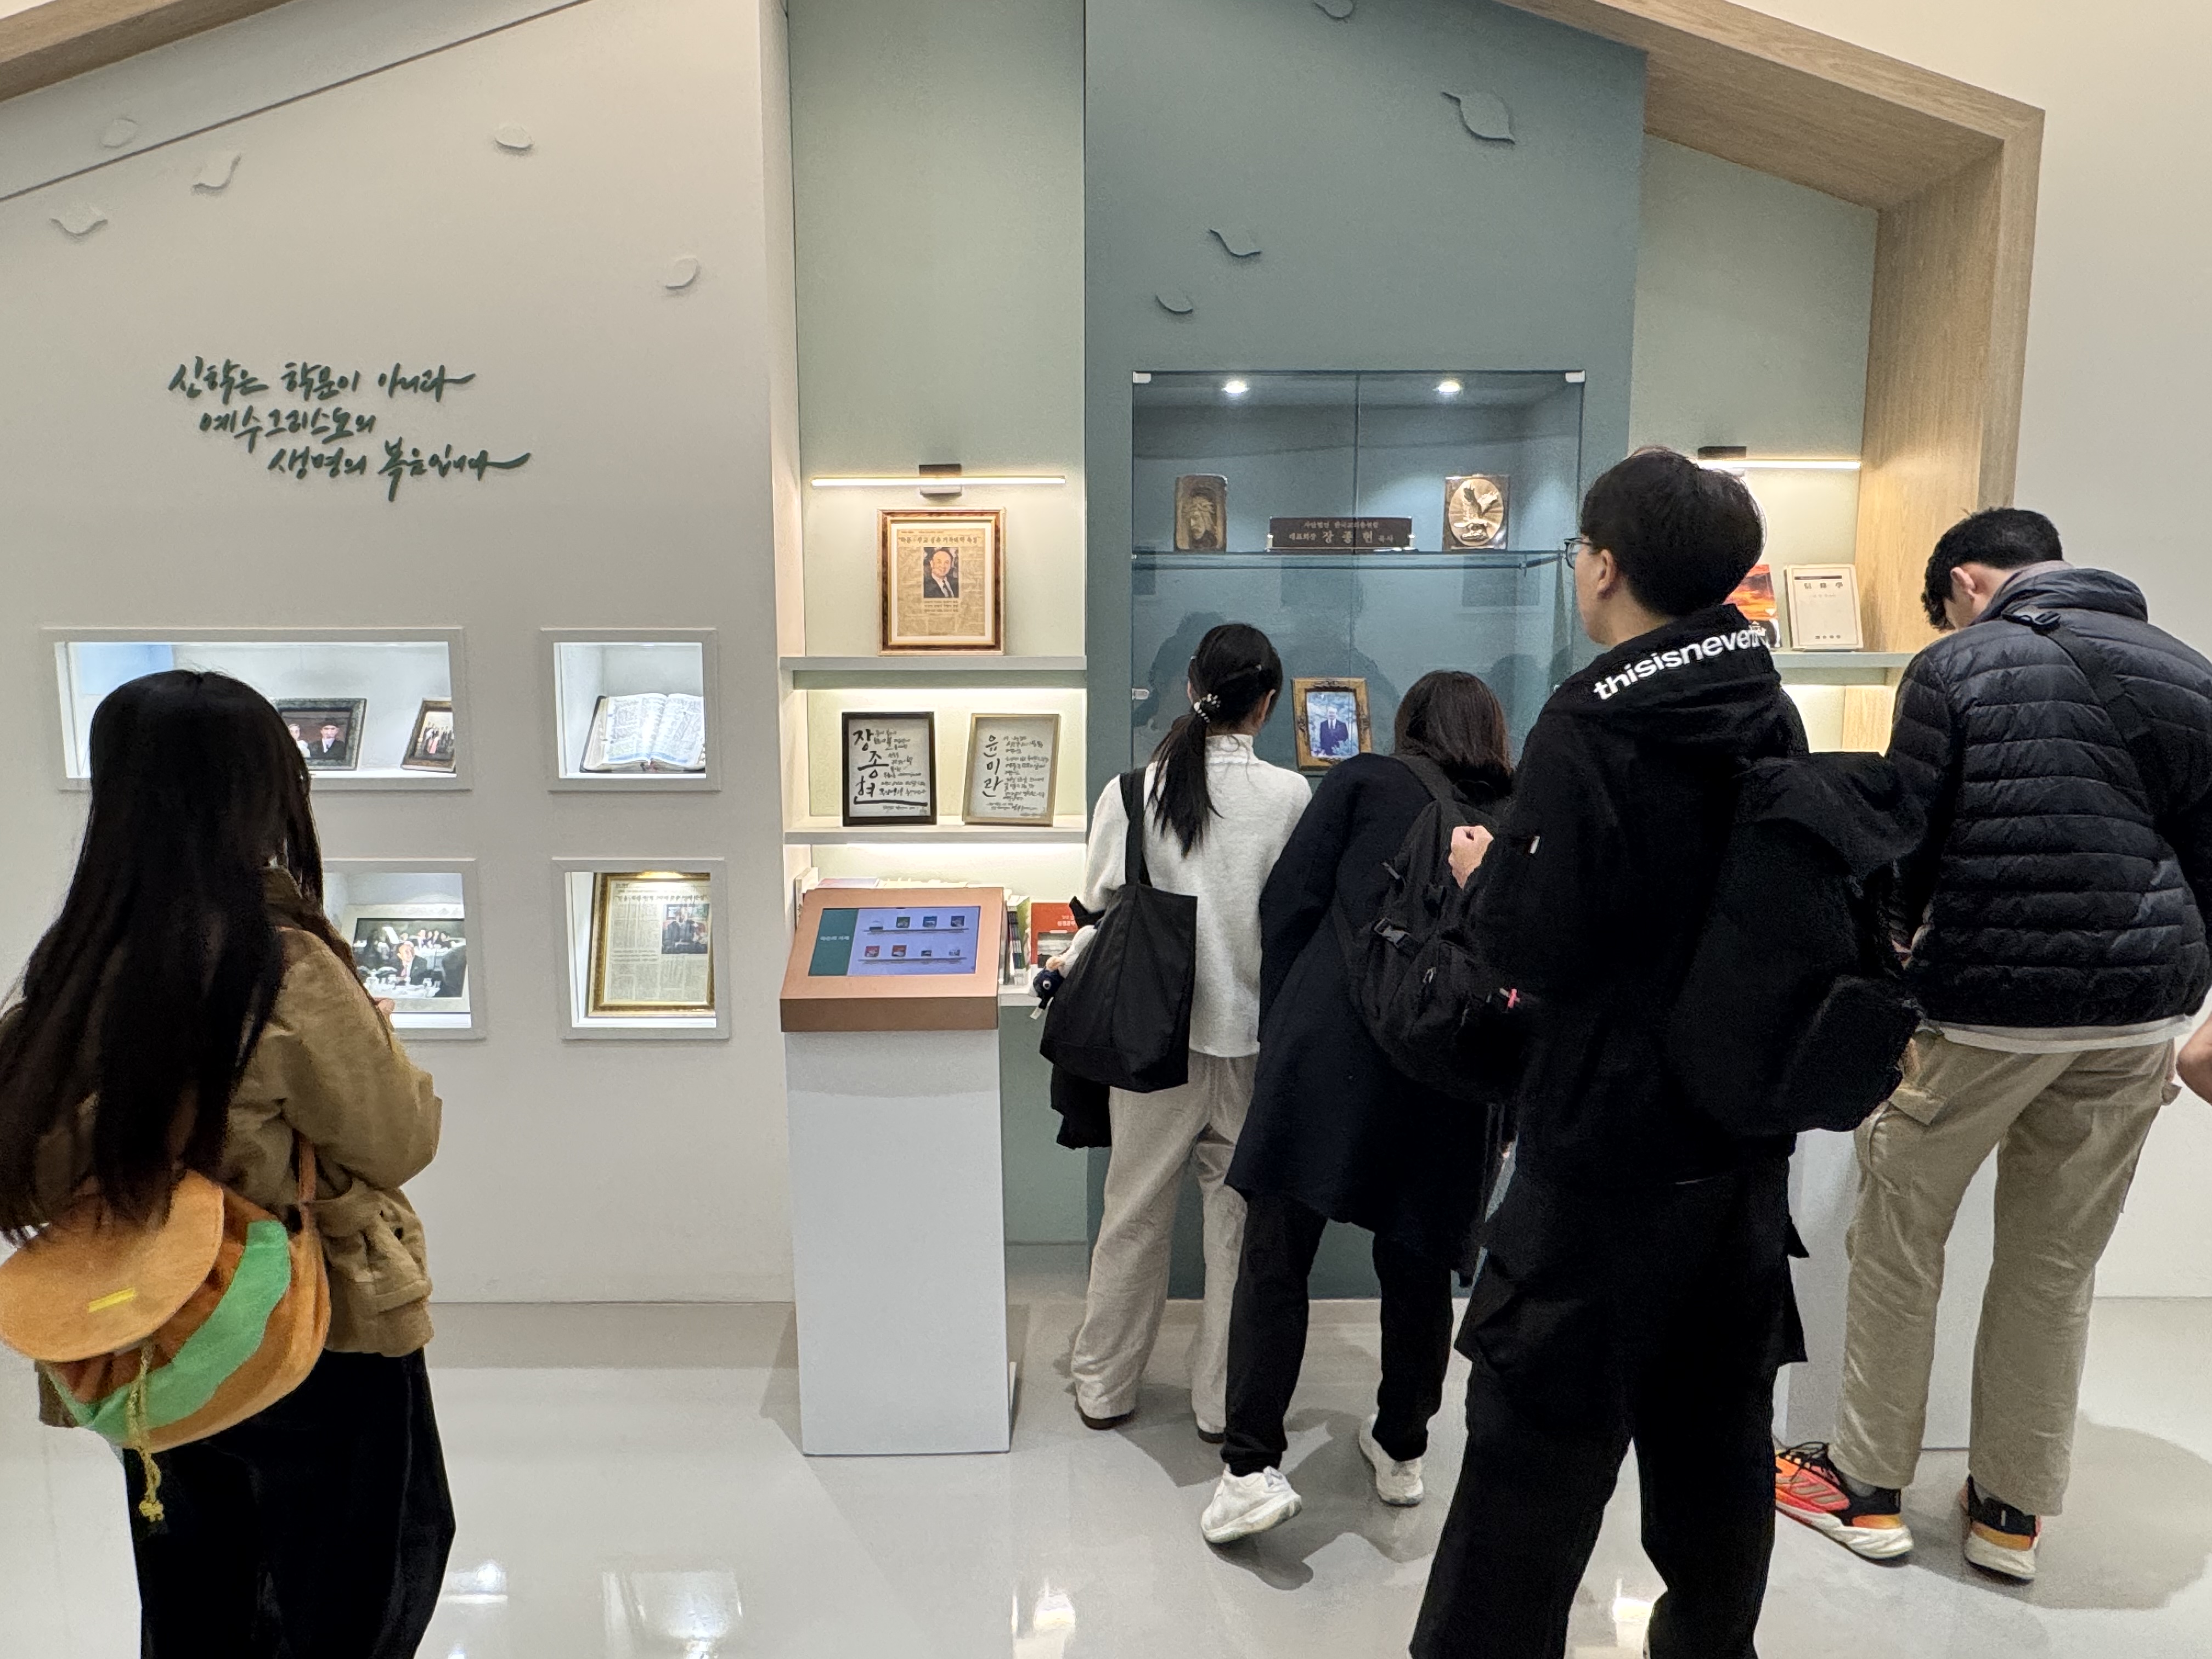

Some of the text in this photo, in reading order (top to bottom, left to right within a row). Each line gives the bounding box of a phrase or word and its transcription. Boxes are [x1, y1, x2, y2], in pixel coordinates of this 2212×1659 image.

[168, 356, 476, 407] 신학은 학문이 아니라
[268, 437, 532, 503] 생명의 복음입니다
